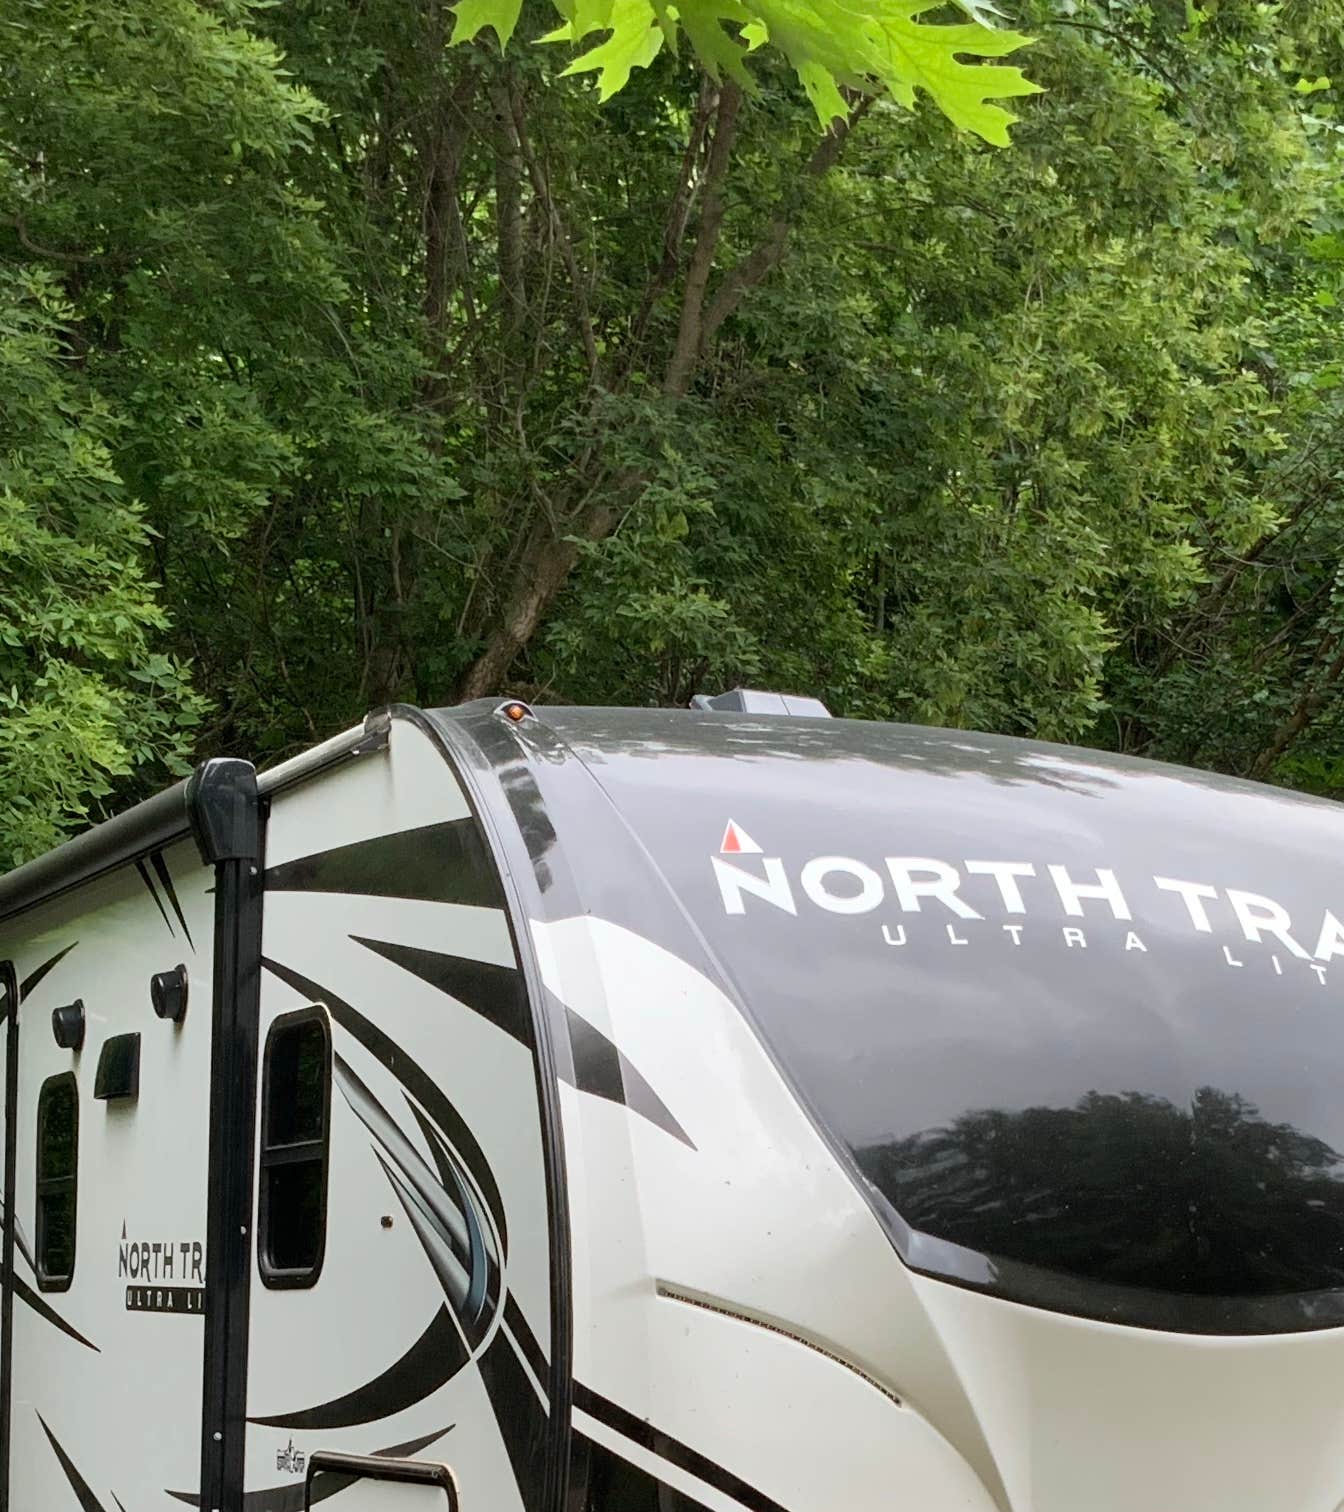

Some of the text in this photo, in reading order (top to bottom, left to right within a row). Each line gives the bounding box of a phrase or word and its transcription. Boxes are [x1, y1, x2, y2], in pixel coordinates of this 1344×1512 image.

[711, 856, 1132, 921] NORTH
[882, 924, 1147, 952] ULTRA
[119, 1242, 204, 1284] NORTH TR
[127, 1290, 174, 1309] ULTRA
